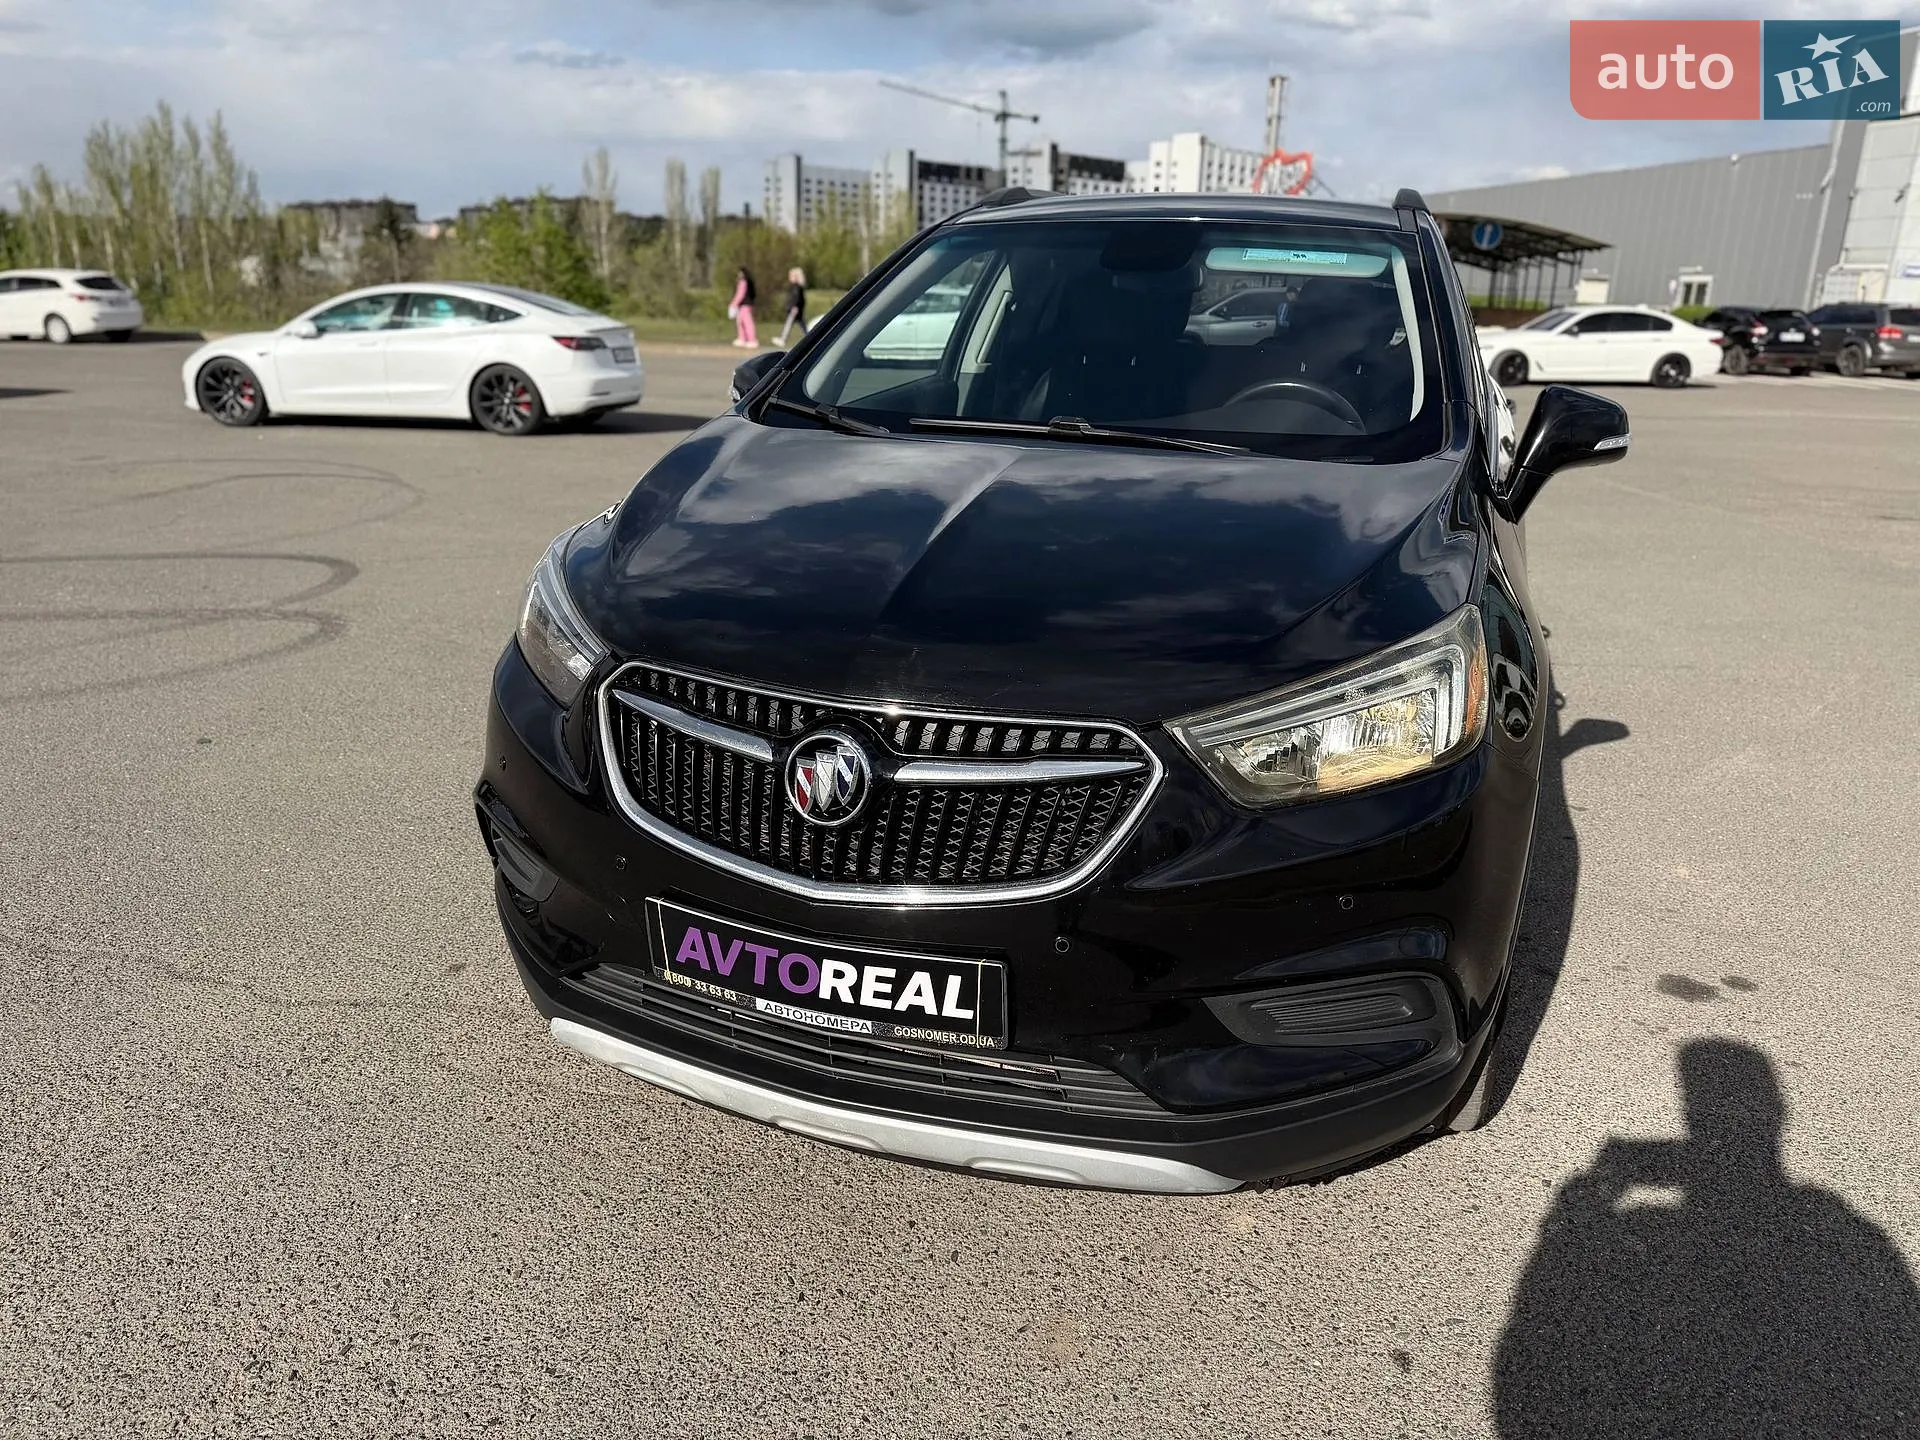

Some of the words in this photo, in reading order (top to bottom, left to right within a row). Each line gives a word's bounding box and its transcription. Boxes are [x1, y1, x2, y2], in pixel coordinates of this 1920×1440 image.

[695, 980, 707, 992] 33
[709, 985, 721, 996] 63
[724, 989, 737, 1001] 63
[764, 1002, 871, 1032] АВТОНОМЕРА
[894, 1026, 995, 1047] GOSNOMER.ODUA
